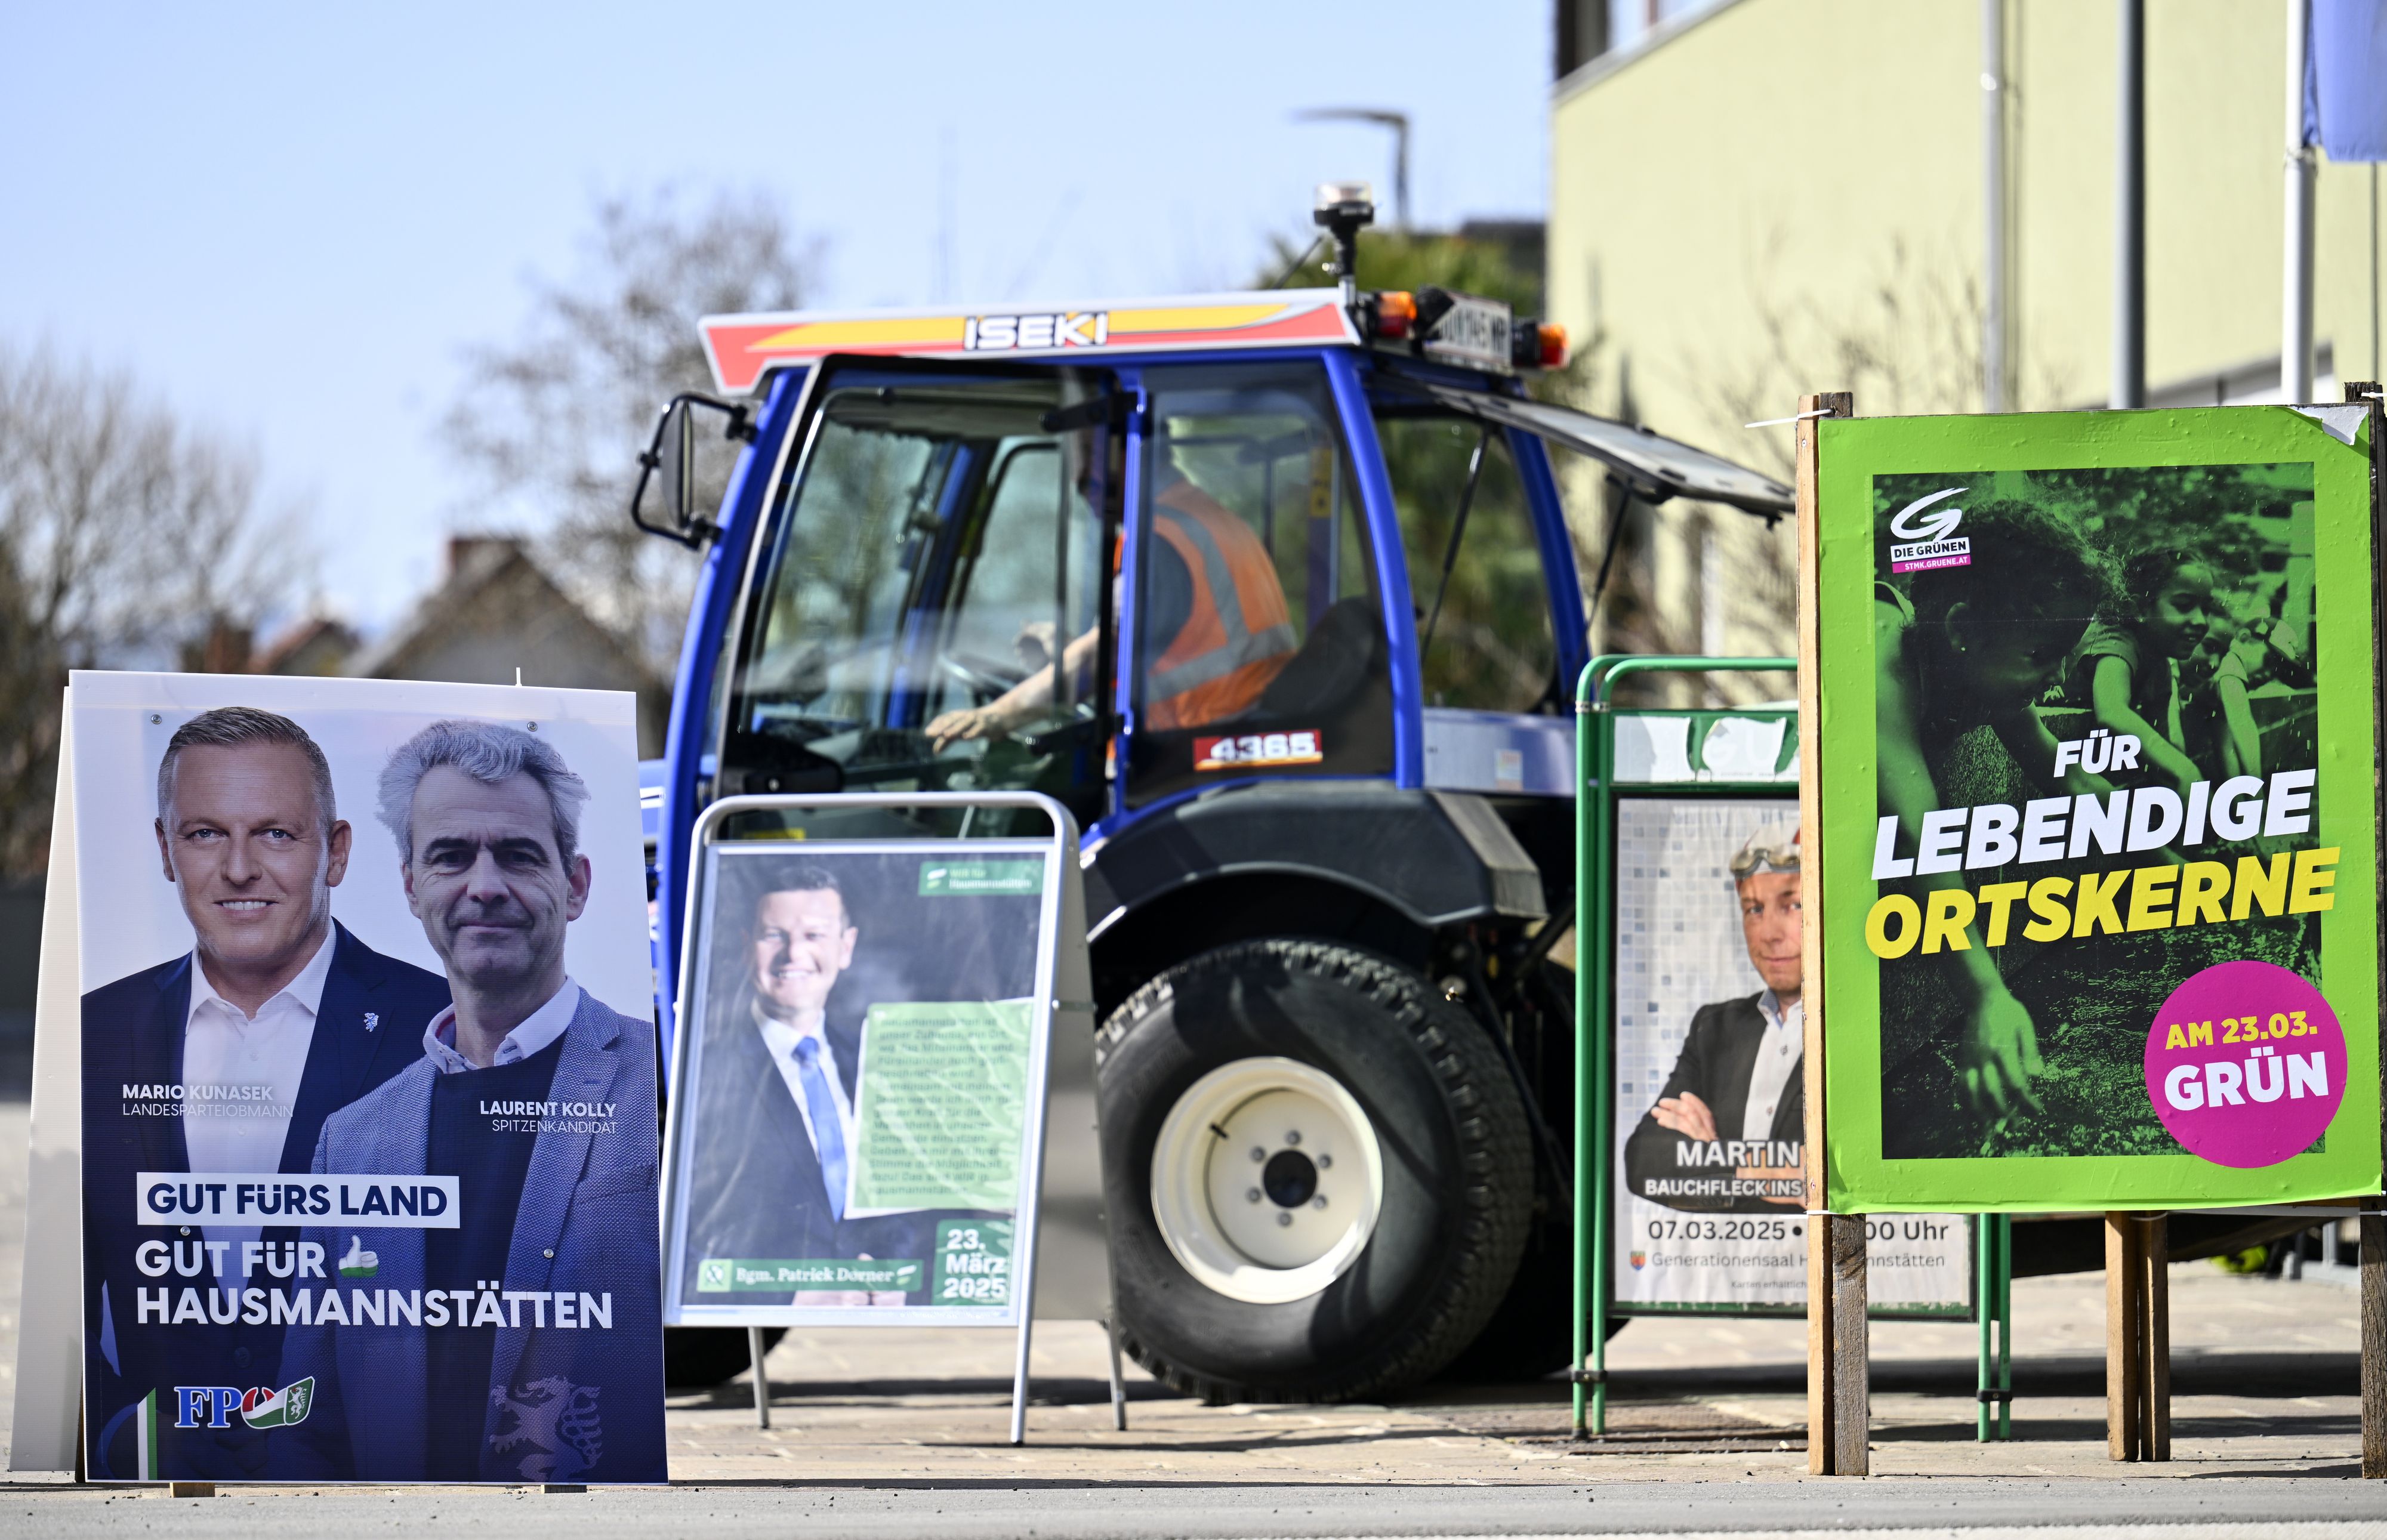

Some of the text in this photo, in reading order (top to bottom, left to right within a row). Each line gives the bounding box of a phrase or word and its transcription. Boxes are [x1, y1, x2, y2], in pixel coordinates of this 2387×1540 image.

[964, 311, 1109, 351] ISEKI
[1894, 542, 1966, 558] DIE GRÜNEN
[1905, 556, 1967, 570] STMK.GRUENE.AT
[1210, 732, 1315, 761] 4365
[2053, 729, 2141, 777] FÜR
[1871, 769, 2316, 879] LEBENDIGE
[1865, 847, 2340, 958] ORTSKERNE
[2165, 1011, 2318, 1050] AM 23.03.
[2164, 1046, 2329, 1111] GRÜN
[123, 1084, 273, 1100] MARIO KUNASEK
[123, 1103, 293, 1117] LANDESPARTEIOBMANN
[480, 1100, 616, 1117] LAURENT KOLLY
[492, 1119, 617, 1134] SPITZENKANDIDAT
[1676, 1140, 1799, 1166] MARTIN
[1645, 1179, 1802, 1196] BAUCHFLECK INS
[147, 1183, 447, 1216] GUT FÜRS LAND
[946, 1229, 986, 1250] 23.
[1648, 1221, 1785, 1240] 07.03.2025
[1904, 1220, 1949, 1240] Uhr
[135, 1240, 327, 1277] GUT FÜR
[945, 1252, 1007, 1274] März
[1652, 1252, 1794, 1267] Generationensaal
[735, 1266, 895, 1285] Bgm. Patrick Dorner
[942, 1277, 1007, 1298] 2025
[137, 1280, 613, 1329] HAUSMANNSTÄTTEN
